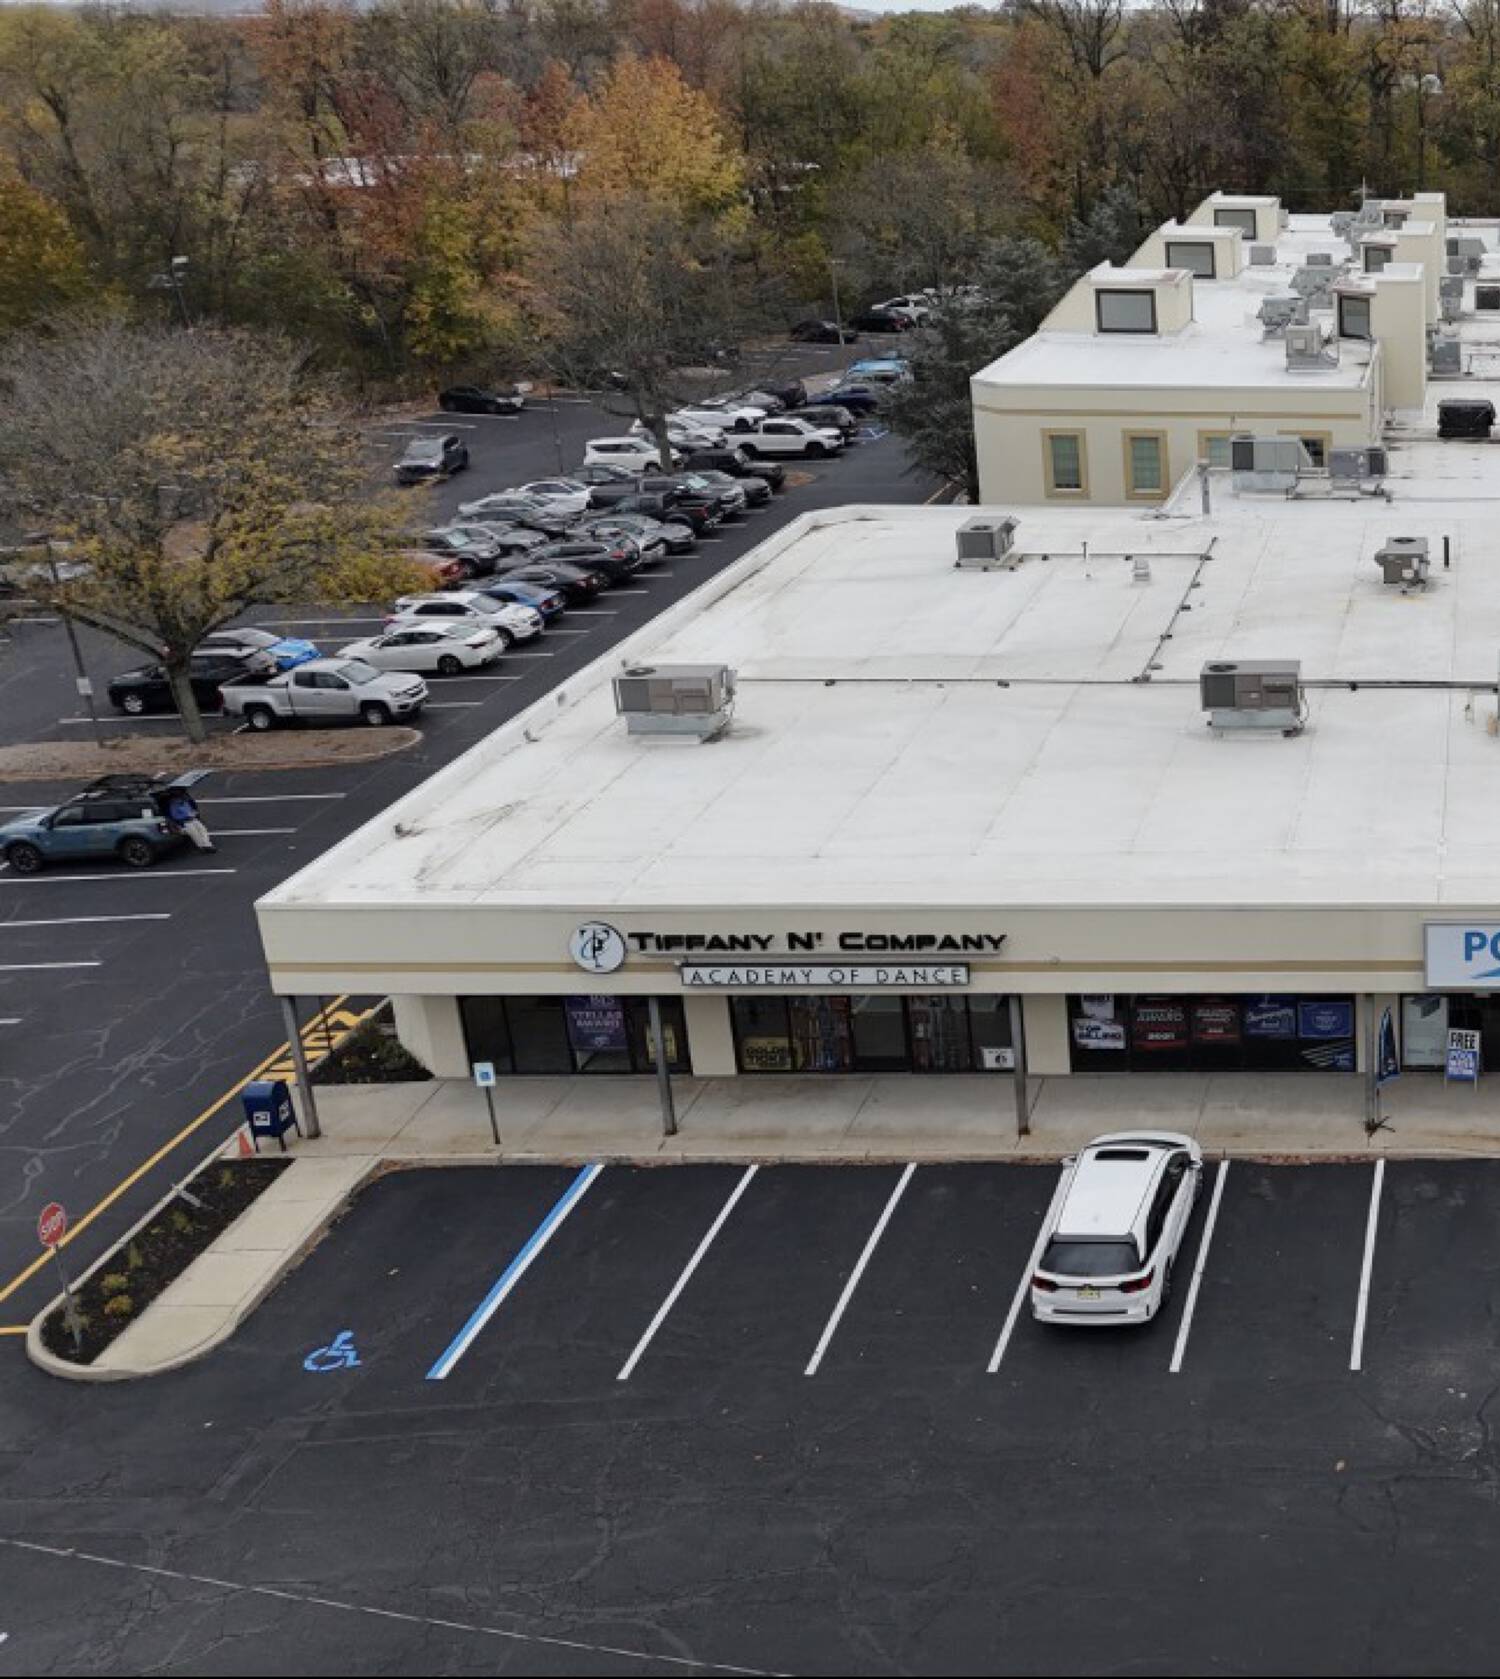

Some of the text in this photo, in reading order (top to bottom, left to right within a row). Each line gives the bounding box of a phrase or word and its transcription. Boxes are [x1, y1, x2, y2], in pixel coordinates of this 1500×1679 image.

[627, 932, 774, 952] TIFFANY
[839, 932, 1007, 952] COMPANY
[689, 968, 963, 985] ACADEMY OF DANCE
[1450, 1032, 1477, 1050] FREE
[40, 1211, 64, 1236] STOP
